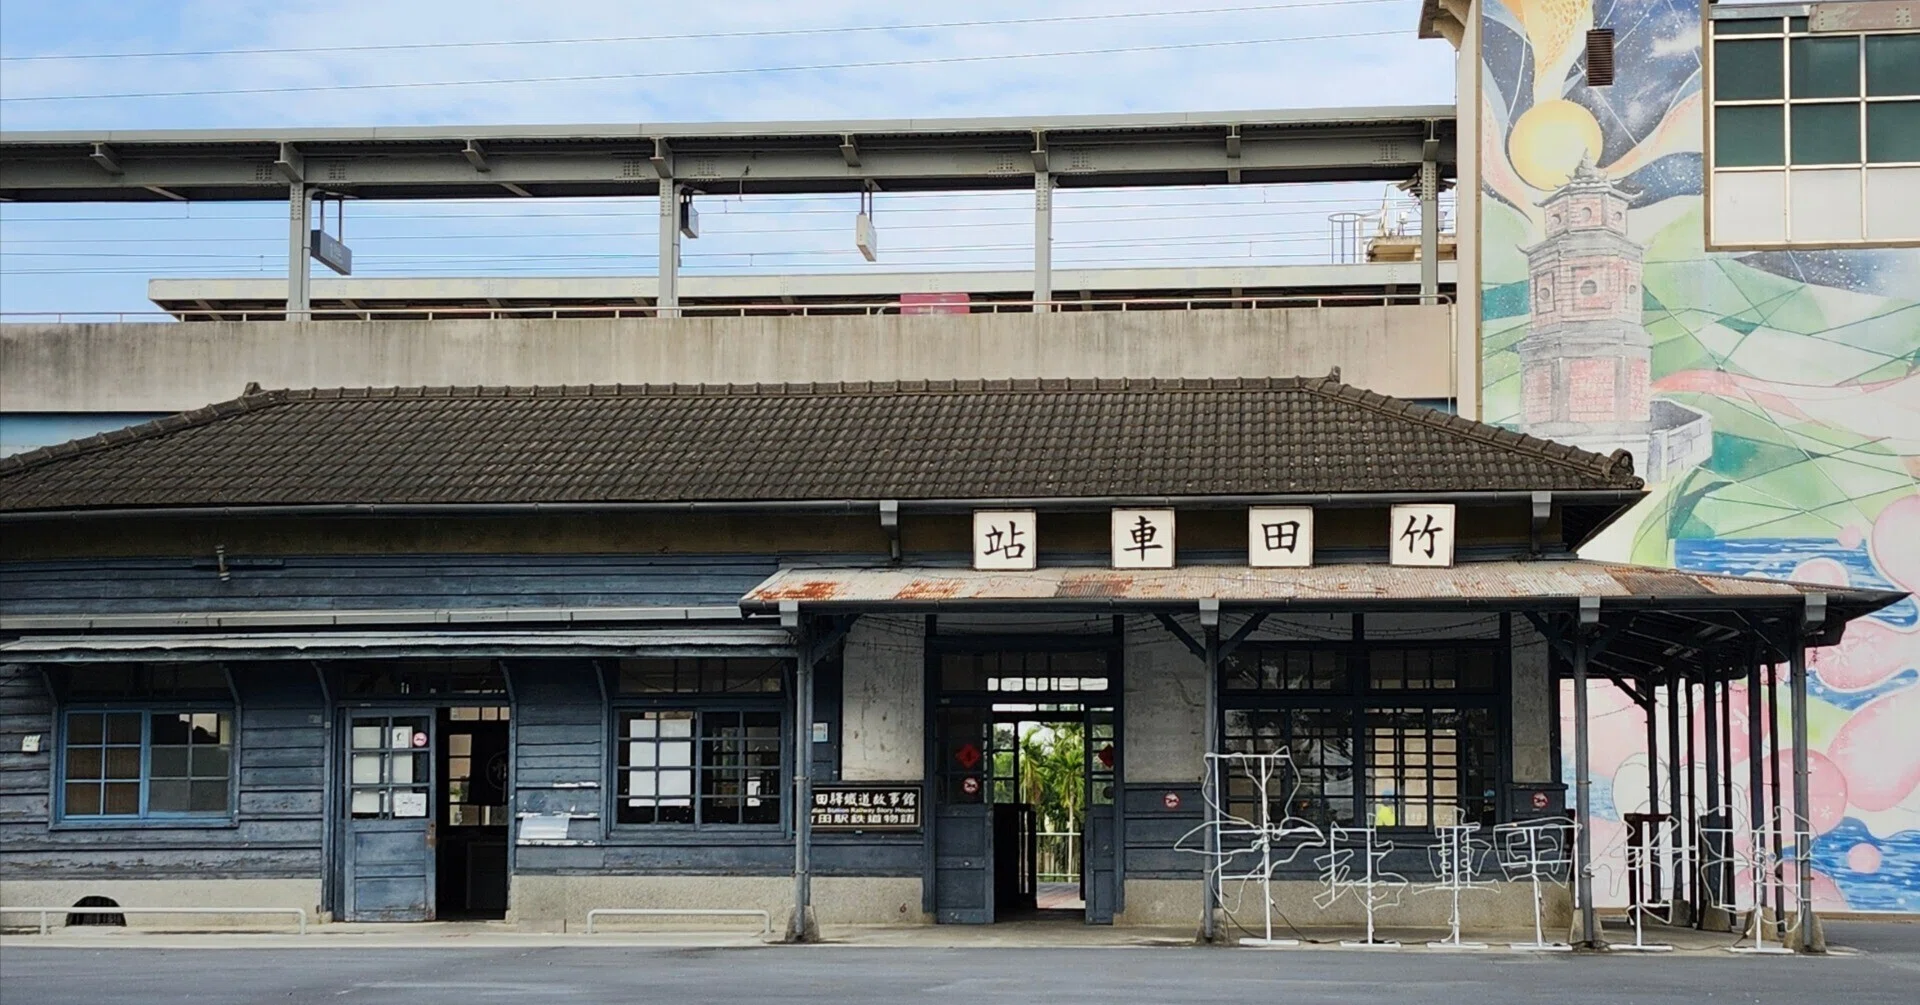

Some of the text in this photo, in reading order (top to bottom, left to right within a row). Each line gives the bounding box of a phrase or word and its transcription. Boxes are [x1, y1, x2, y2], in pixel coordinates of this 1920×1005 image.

[810, 791, 917, 807] 田驛鐵道故事館
[850, 807, 875, 815] Railway
[876, 807, 894, 815] Story
